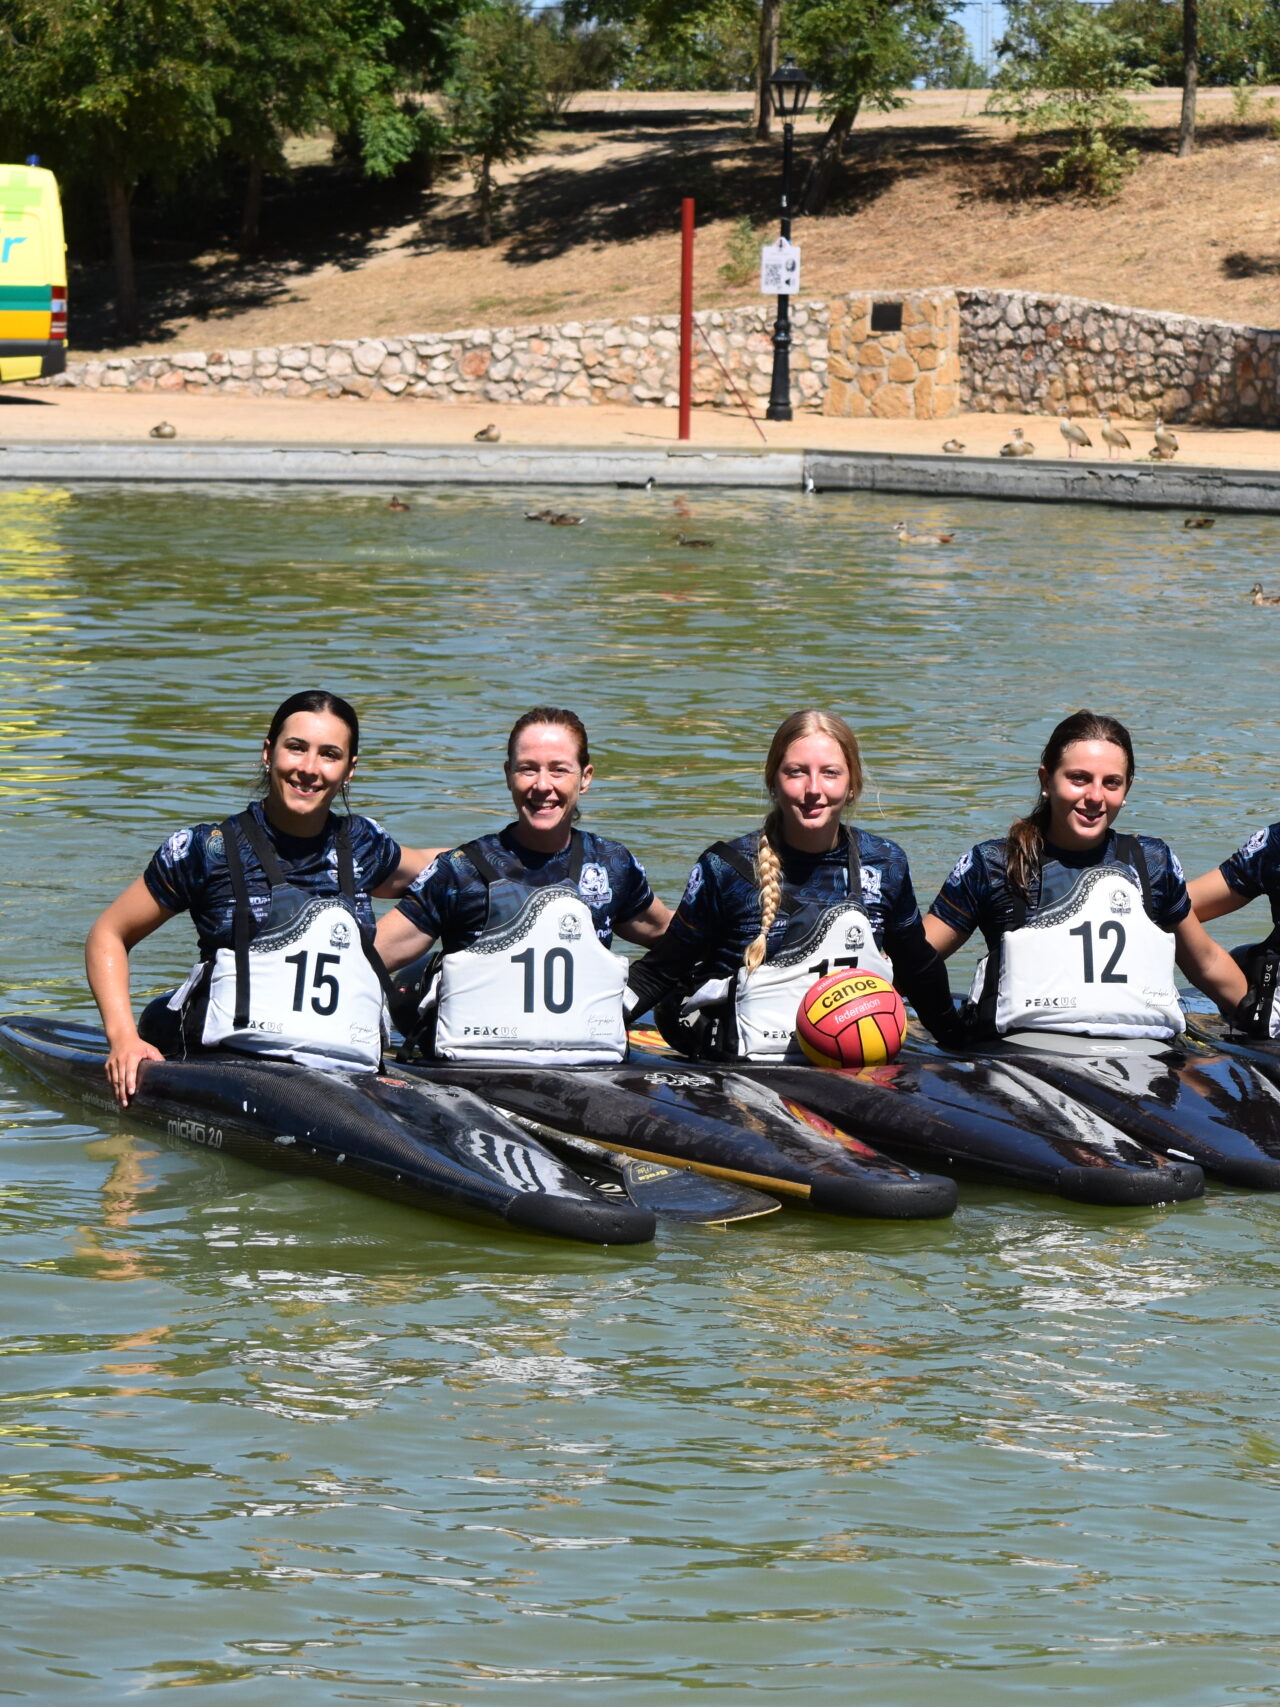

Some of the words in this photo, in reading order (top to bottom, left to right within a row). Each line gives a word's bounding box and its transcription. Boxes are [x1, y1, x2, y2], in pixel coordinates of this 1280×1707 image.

[285, 950, 341, 1016] 15
[511, 947, 574, 1014] 10
[1069, 920, 1128, 983] 12
[821, 979, 878, 1009] canoe
[834, 998, 881, 1024] federation
